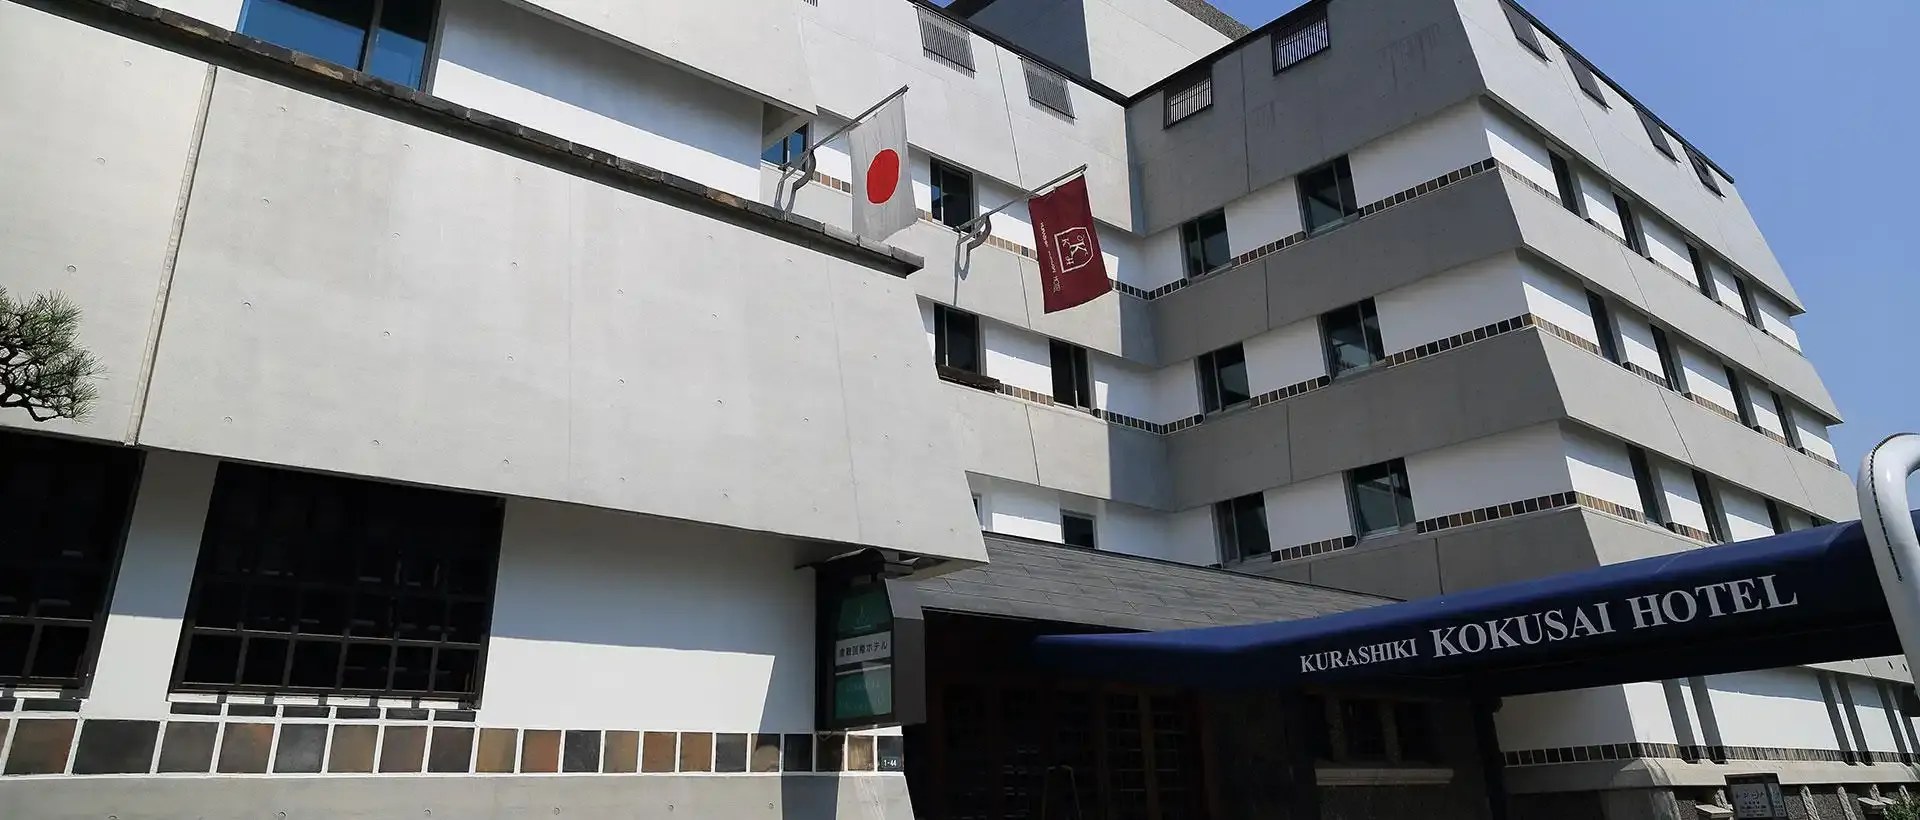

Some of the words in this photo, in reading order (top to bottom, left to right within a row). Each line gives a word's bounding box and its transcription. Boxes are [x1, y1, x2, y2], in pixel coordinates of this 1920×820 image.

[1300, 638, 1419, 673] KURASHIKI
[1430, 602, 1616, 658] KOKUSAI
[1628, 574, 1798, 629] HOTEL
